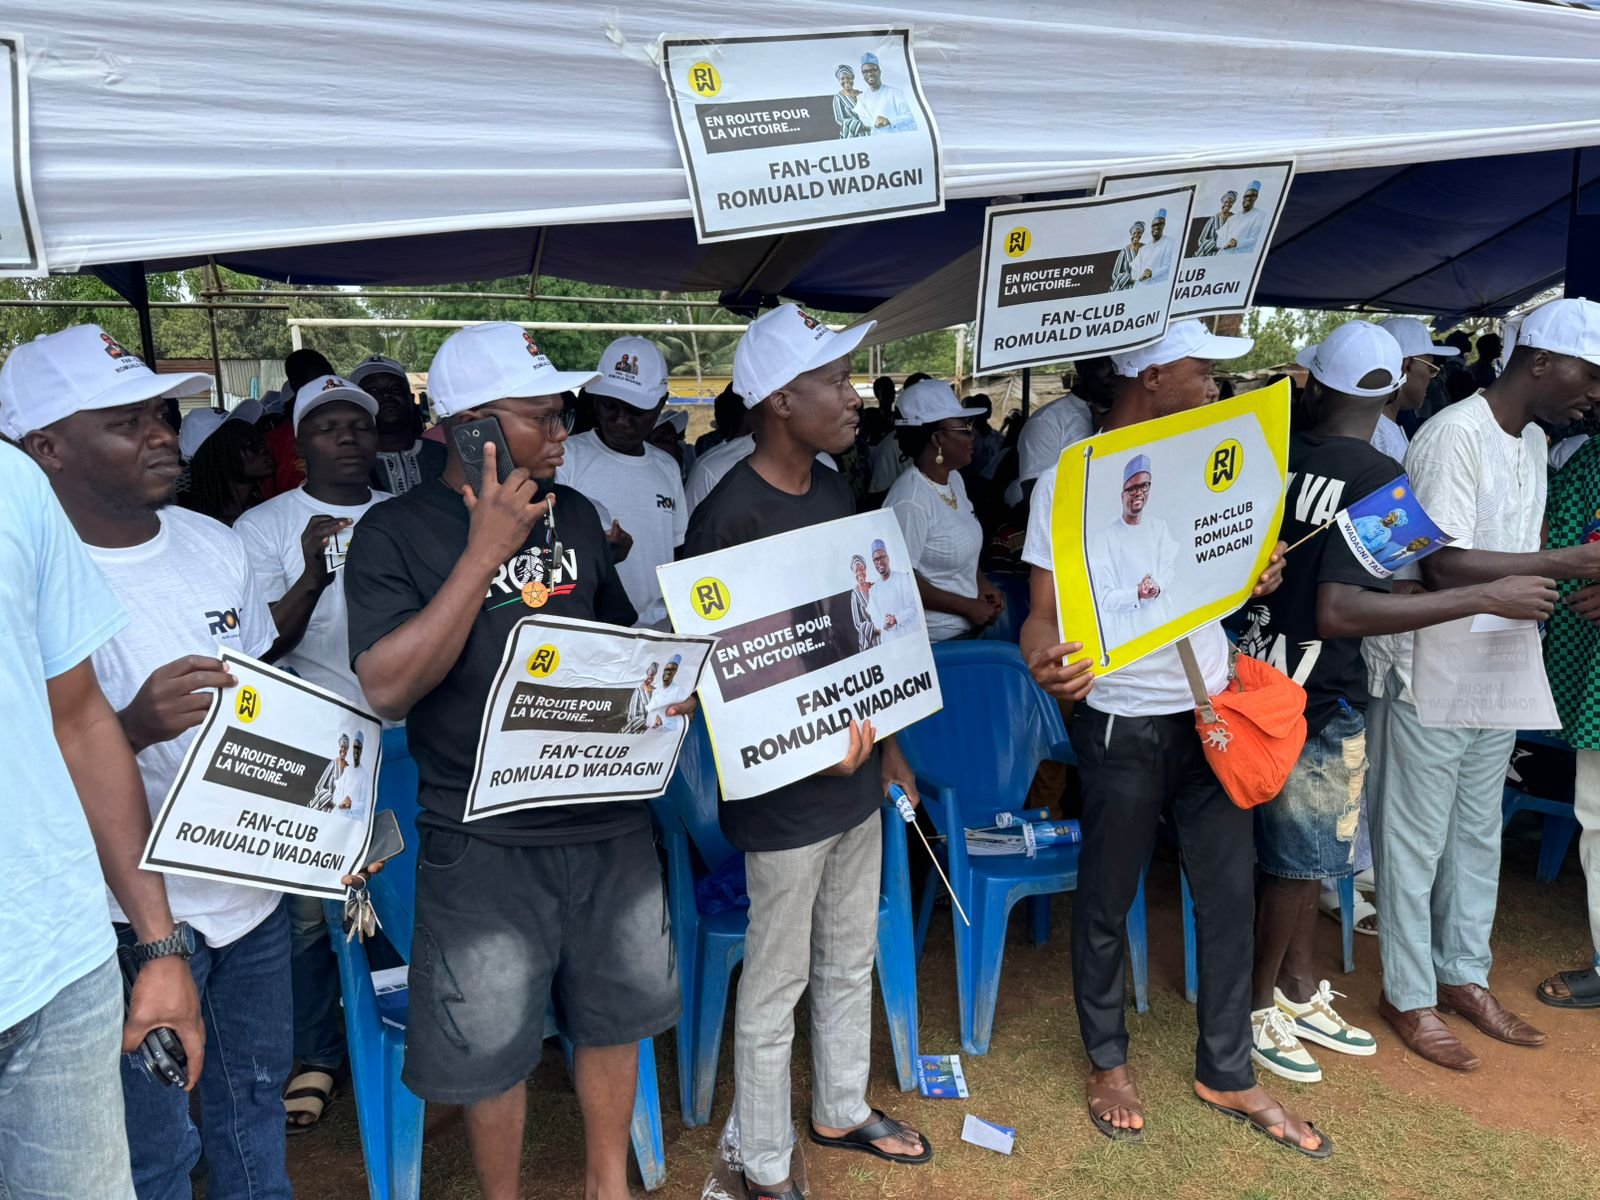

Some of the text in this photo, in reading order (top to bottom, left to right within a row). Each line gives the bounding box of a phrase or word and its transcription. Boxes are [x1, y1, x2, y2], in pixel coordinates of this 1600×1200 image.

[704, 108, 810, 128] EN ROUTE POUR
[708, 122, 801, 140] LA VICTOIRE...
[769, 152, 871, 180] FAN-CLUB
[717, 168, 923, 210] ROMUALD WADAGNI
[1004, 278, 1081, 295] LA VICTOIRE...
[1005, 264, 1095, 284] EN ROUTE POUR
[1041, 303, 1126, 327] FAN-CLUB
[994, 310, 1160, 351] ROMUALD WADAGNI
[1194, 501, 1253, 531] FAN-CLUB
[1296, 473, 1346, 529] VA
[1194, 518, 1254, 548] ROMUALD
[1344, 522, 1369, 560] WADAGNI
[1196, 534, 1253, 564] WADAGNI
[716, 615, 832, 663] EN ROUTE POUR
[722, 638, 825, 680] LA VICTOIRE...
[515, 694, 612, 712] EN ROUTE POUR
[796, 664, 885, 717] FAN-CLUB
[510, 706, 594, 723] LA VICTOIRE...
[740, 671, 932, 769] ROMUALD WADAGNI
[222, 741, 306, 777] EN ROUTE POUR
[539, 744, 630, 760] FAN-CLUB
[215, 757, 288, 787] LA VICTOIRE...
[489, 761, 663, 788] ROMUALD WADAGNI
[236, 809, 318, 843] FAN-CLUB
[175, 821, 345, 871] ROMUALD WADAGNI
